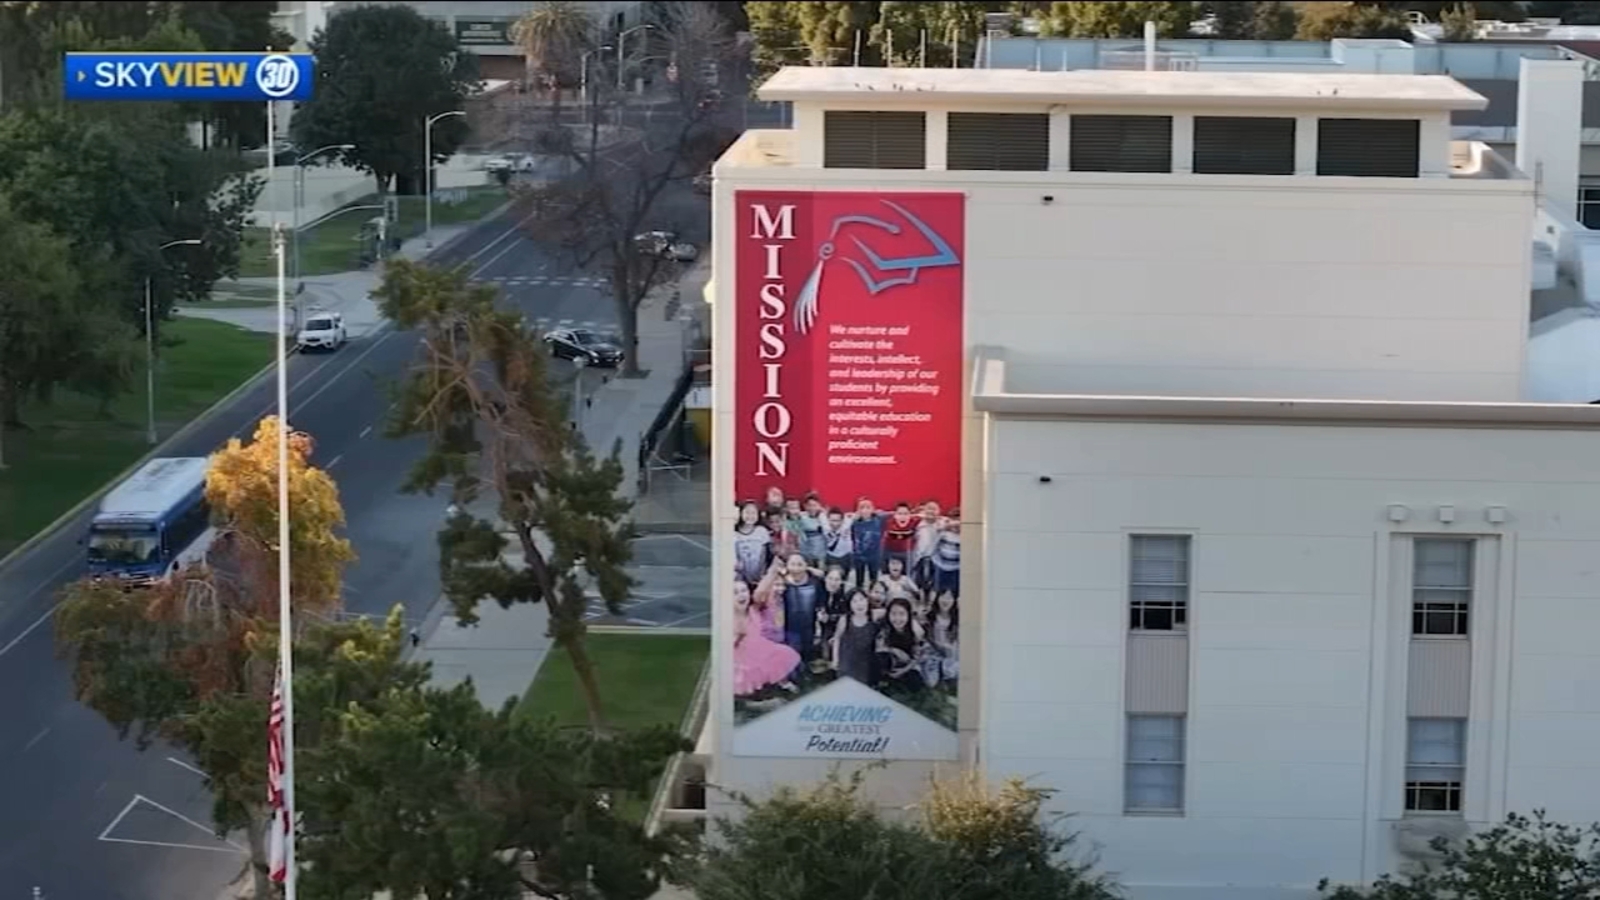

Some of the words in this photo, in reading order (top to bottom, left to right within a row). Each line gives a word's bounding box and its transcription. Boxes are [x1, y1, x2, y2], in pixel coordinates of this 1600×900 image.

[829, 324, 846, 335] We
[847, 326, 887, 336] nurture
[888, 324, 910, 336] and
[750, 203, 797, 477] MISSION
[828, 339, 874, 350] cultivate
[875, 339, 894, 350] the
[828, 353, 876, 365] interests,
[877, 354, 921, 366] intellect,
[828, 367, 851, 379] and
[851, 367, 905, 381] leadership
[906, 368, 919, 380] of
[919, 370, 939, 379] our
[828, 382, 873, 393] students
[874, 382, 889, 396] by
[888, 383, 940, 397] providing
[828, 398, 843, 407] an
[844, 397, 893, 409] excellent,
[828, 411, 877, 424] equitable
[879, 411, 932, 422] education
[828, 425, 840, 436] in
[840, 427, 849, 436] a
[849, 425, 899, 439] culturally
[827, 439, 879, 452] proficient
[827, 454, 898, 465] environment.
[799, 704, 893, 723] ACHIEVING
[817, 724, 881, 736] GREATEST
[805, 735, 890, 754] Potential!
